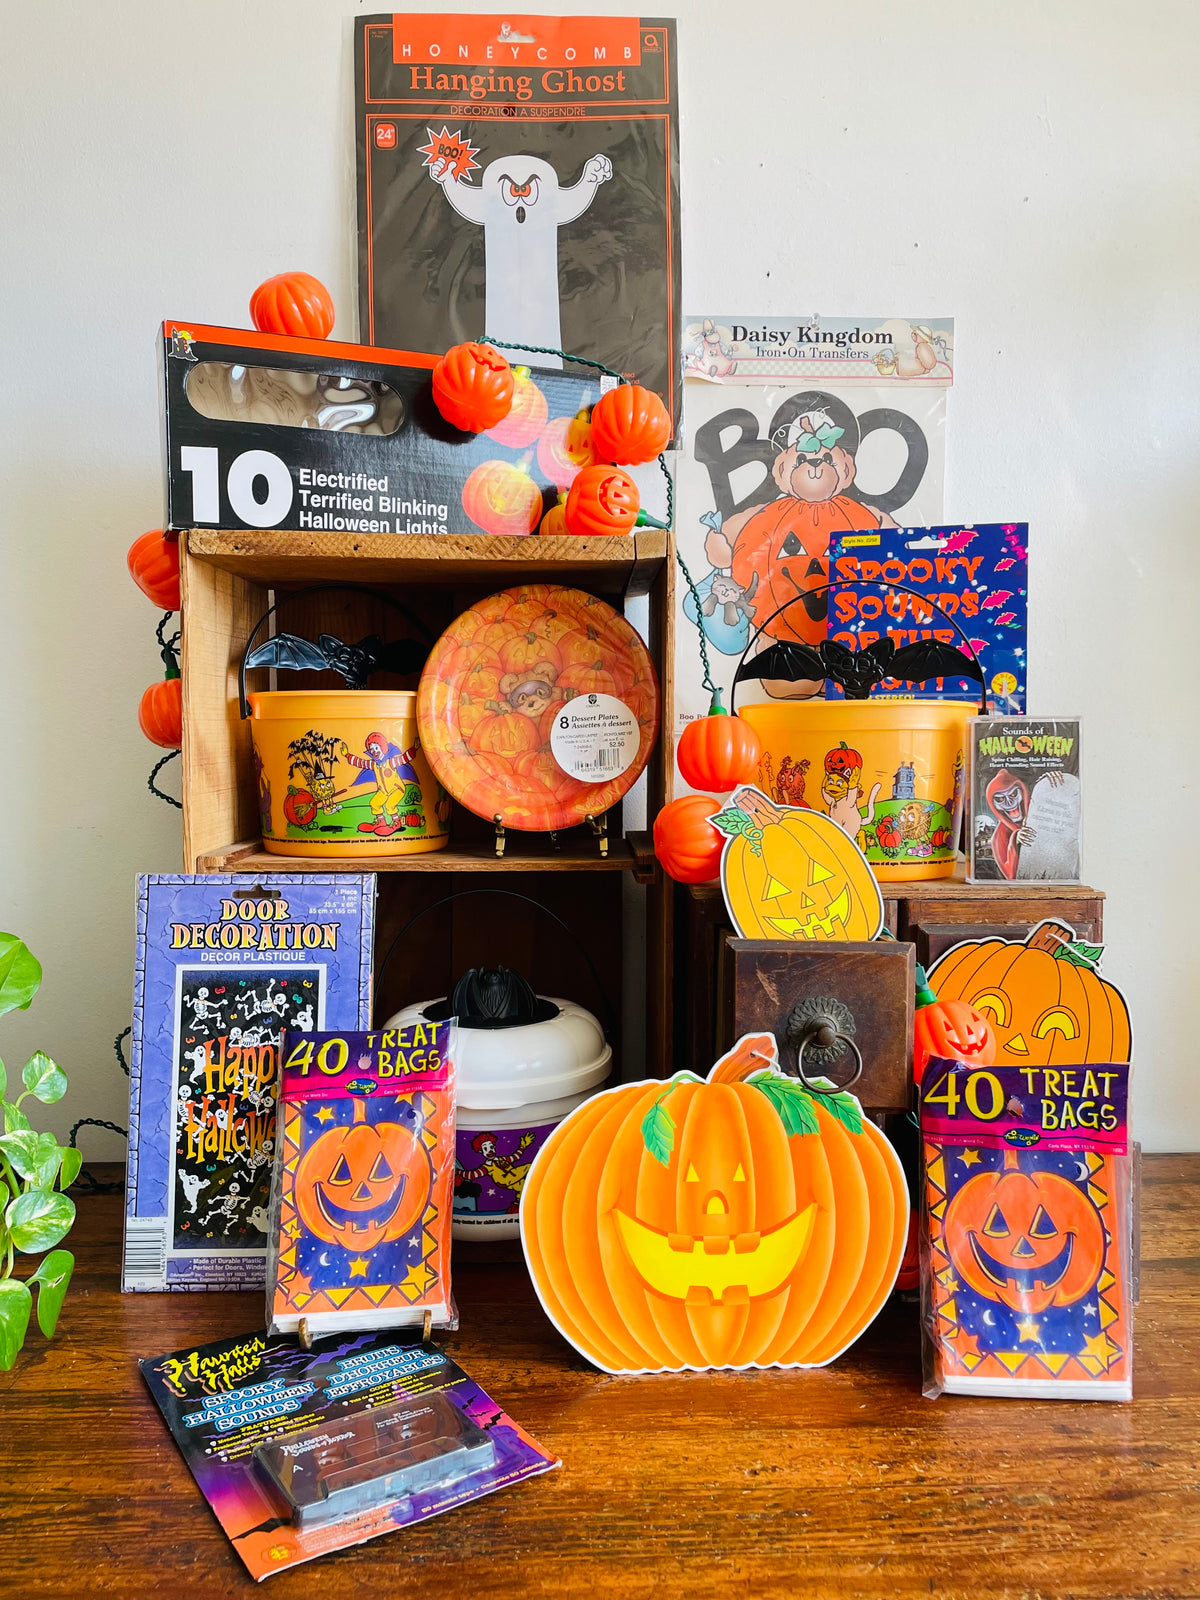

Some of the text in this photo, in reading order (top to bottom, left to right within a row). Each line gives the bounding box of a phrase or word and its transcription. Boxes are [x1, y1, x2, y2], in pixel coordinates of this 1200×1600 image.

[410, 66, 626, 100] Hanging Ghost
[450, 105, 517, 116] DECORATION
[530, 106, 586, 116] SUSPENDRE
[438, 144, 464, 160] BOO!
[731, 326, 893, 346] Daisy Kingdom
[809, 346, 869, 359] Transfers
[694, 391, 929, 516] BOO
[181, 446, 293, 528] 10
[300, 468, 388, 492] Electrified
[300, 490, 448, 522] Terrified Blinking
[300, 511, 448, 534] Halloween Lights
[835, 556, 984, 588] SPOOKY
[834, 592, 980, 624] SOUNDS
[560, 716, 569, 729] 8
[1002, 727, 1033, 735] Sounds
[980, 735, 1074, 757] HALLOWEEN
[220, 899, 290, 922] DOOR
[170, 922, 341, 952] DECORATION
[201, 952, 306, 962] DECOR PLASTIQUE
[285, 1022, 443, 1076] 40 TREAT
[378, 1050, 441, 1078] BAGS
[203, 1036, 278, 1101] Happ
[924, 1068, 1119, 1120] 40 TREAT
[1041, 1099, 1118, 1130] BAGS
[161, 1337, 266, 1392] Haunted
[201, 1354, 262, 1390] Halls
[328, 1350, 425, 1385] D'HORREUR
[340, 1346, 402, 1370] BRUITS
[324, 1355, 444, 1398] EFFROYABLES
[184, 1383, 314, 1426] HALLOWEEN
[204, 1378, 284, 1408] SPOOKY
[216, 1400, 300, 1431] SOUNDS
[293, 1465, 303, 1473] A
